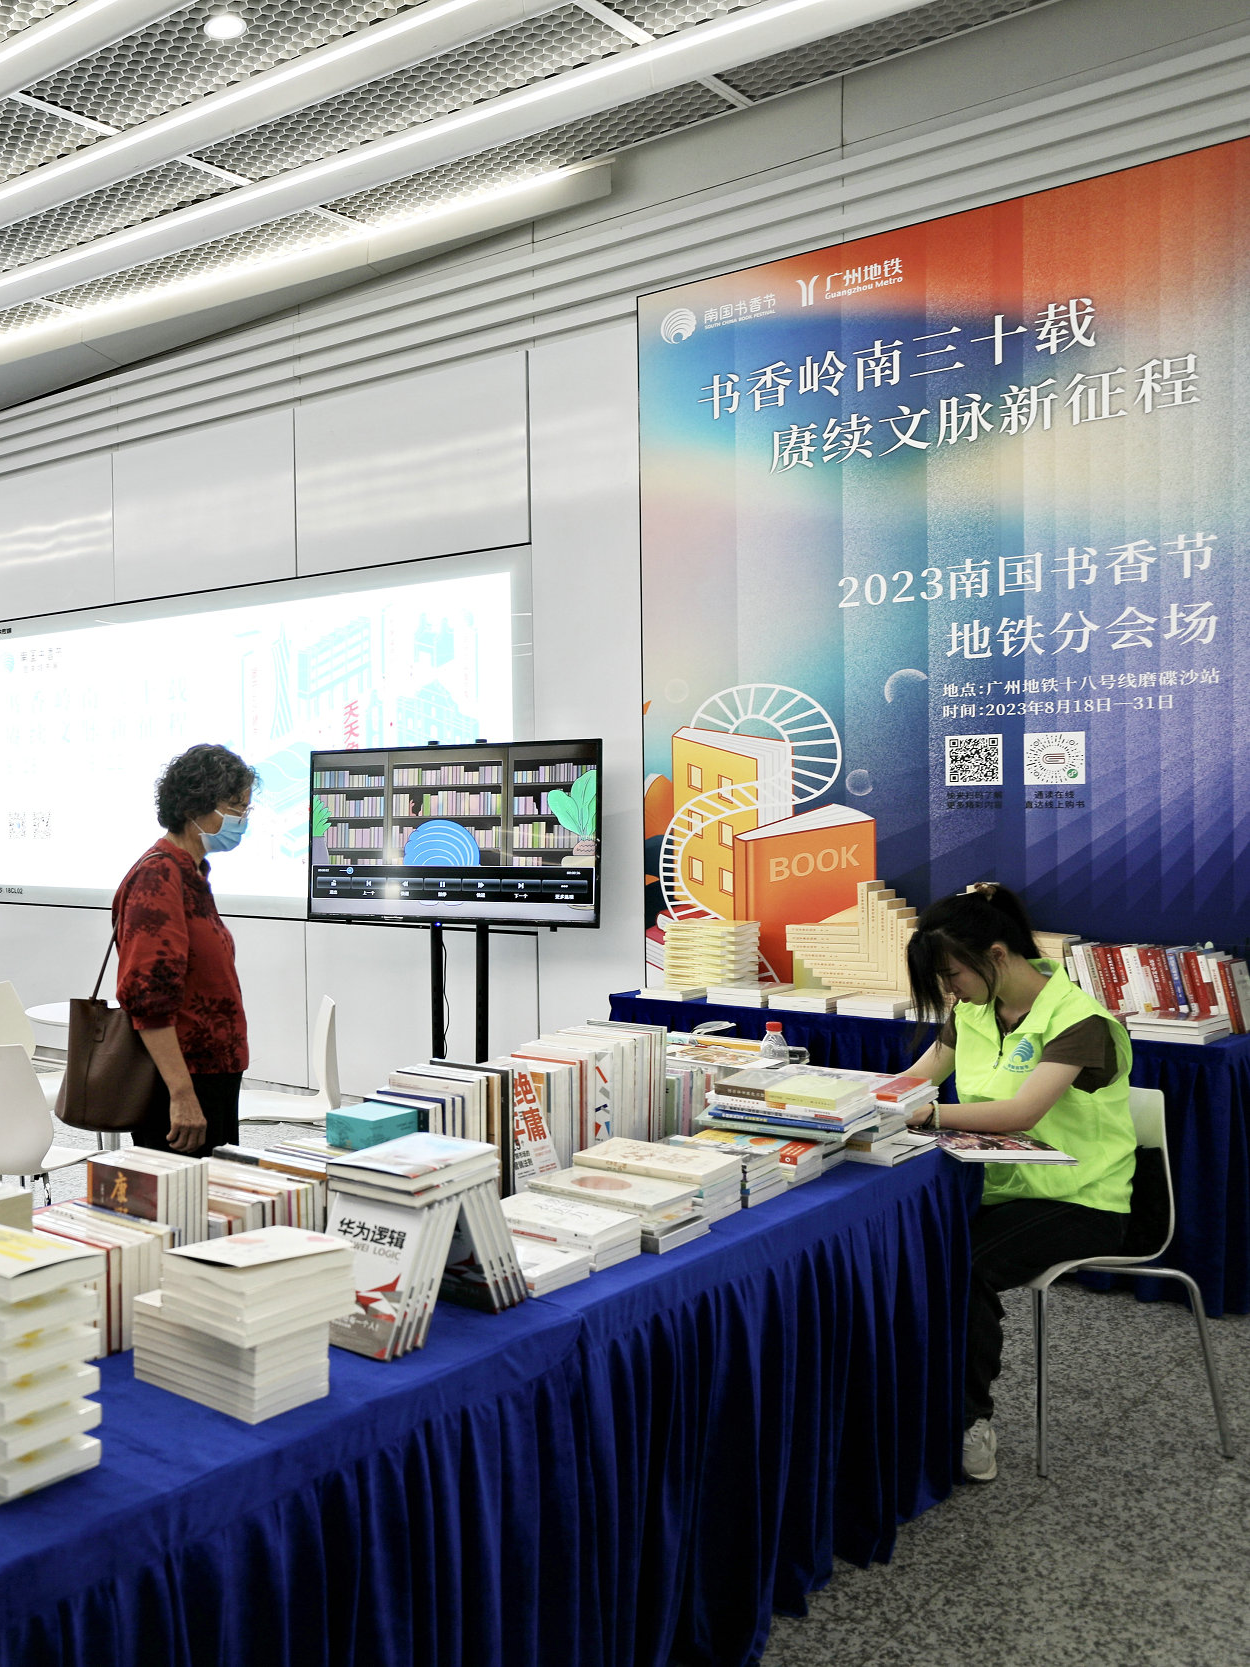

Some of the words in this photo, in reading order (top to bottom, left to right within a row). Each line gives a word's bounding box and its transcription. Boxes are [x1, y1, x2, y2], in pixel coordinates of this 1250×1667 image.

[825, 257, 903, 292] 广州地铁
[825, 283, 873, 300] Guangzhou
[875, 275, 903, 289] Metro
[704, 293, 776, 324] 南国书香节
[697, 298, 1096, 421] 书香岭南三十载
[769, 352, 1202, 475] 赓续文脉新征程
[837, 532, 1218, 608] 2023南国书香节
[945, 601, 1219, 660] 地铁分会场
[1025, 800, 1085, 809] 直达线上购书
[769, 844, 860, 882] BOOK
[337, 1216, 407, 1250] 华为逻辑
[373, 1246, 401, 1261] LOGIC
